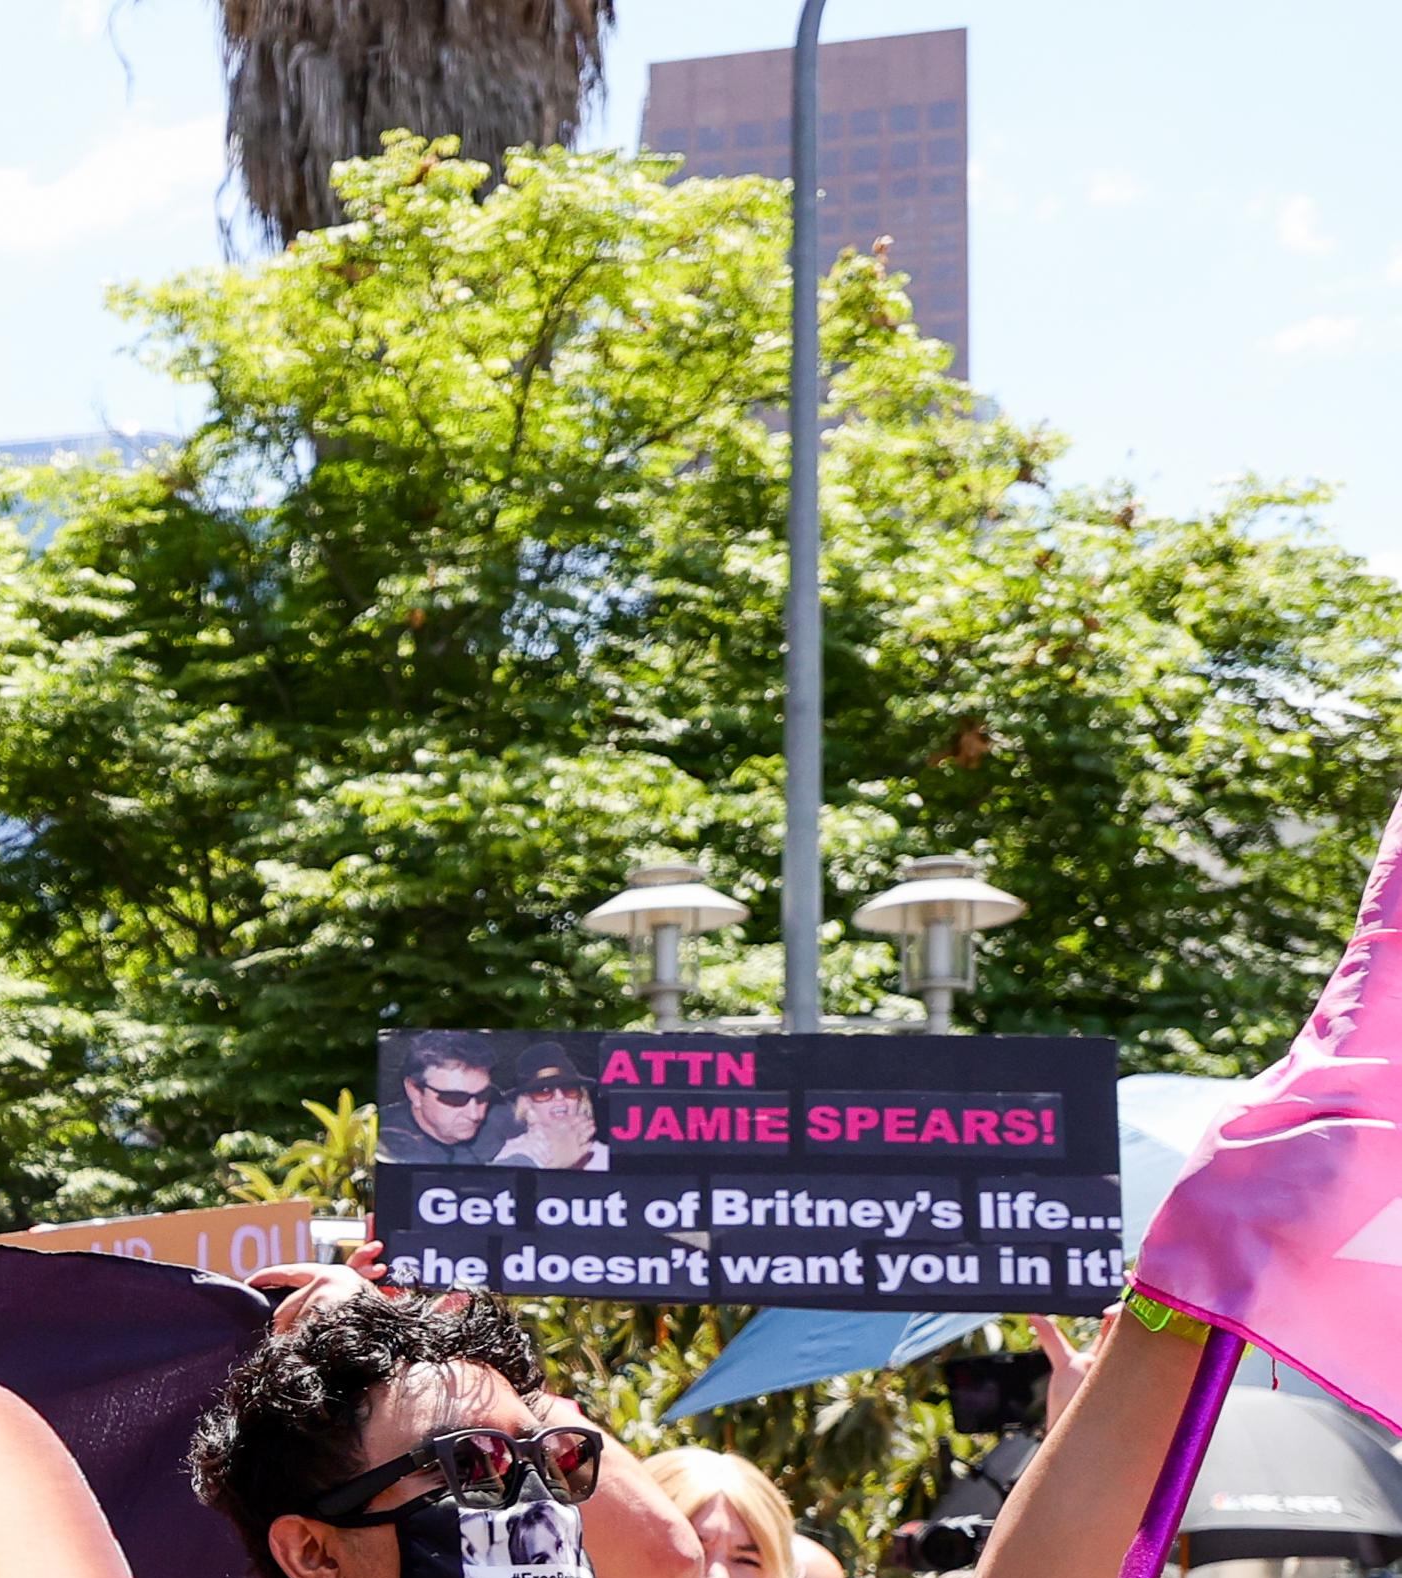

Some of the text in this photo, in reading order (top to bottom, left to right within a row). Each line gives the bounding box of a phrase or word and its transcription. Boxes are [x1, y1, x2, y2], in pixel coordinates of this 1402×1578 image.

[600, 1049, 757, 1088] ATTN
[609, 1104, 1057, 1147] JAMIE SPEARS!
[417, 1187, 518, 1229] Get
[535, 1188, 629, 1229] out
[643, 1187, 702, 1229] of
[978, 1190, 1123, 1232] life...
[391, 1246, 489, 1286] she
[721, 1247, 865, 1287] want
[876, 1255, 980, 1294] you
[998, 1247, 1051, 1286] in
[1067, 1248, 1123, 1288] it!
